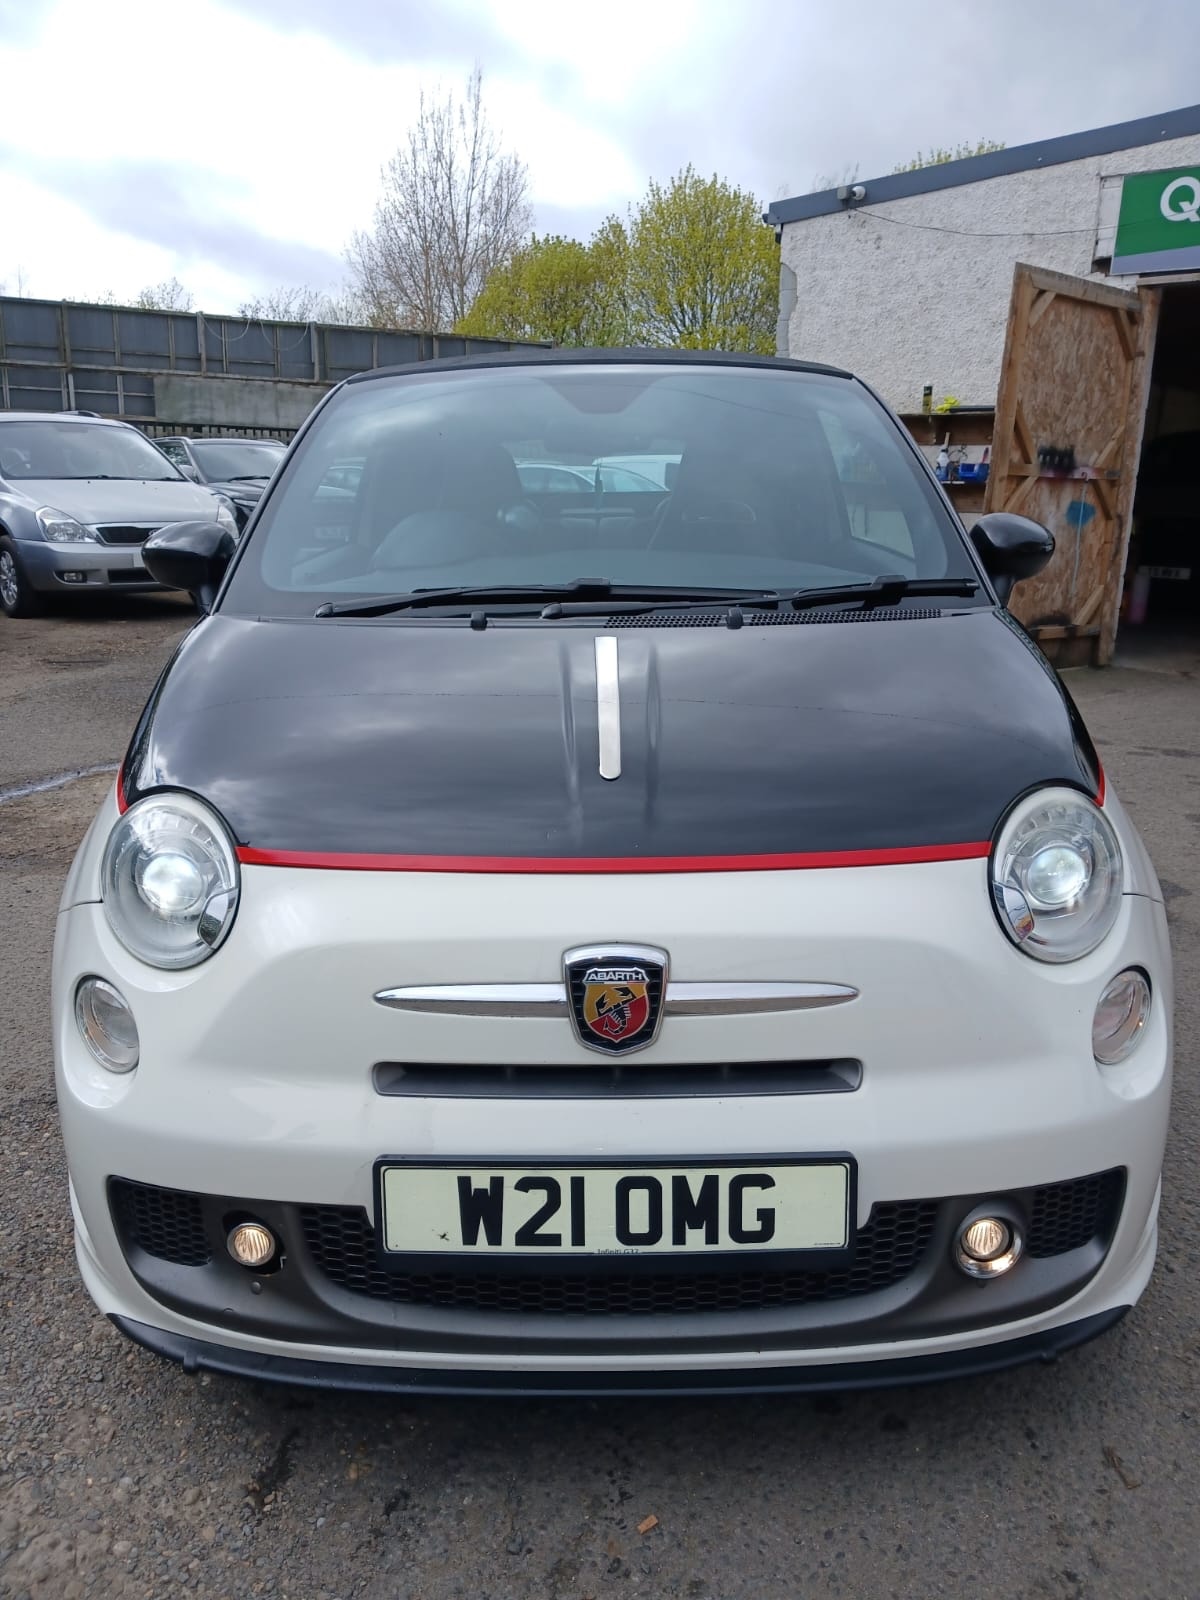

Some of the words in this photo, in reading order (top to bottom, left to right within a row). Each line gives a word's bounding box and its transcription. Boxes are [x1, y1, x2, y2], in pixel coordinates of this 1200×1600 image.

[588, 971, 642, 981] ABARTH
[457, 1175, 585, 1247] W21
[615, 1173, 776, 1246] OMG
